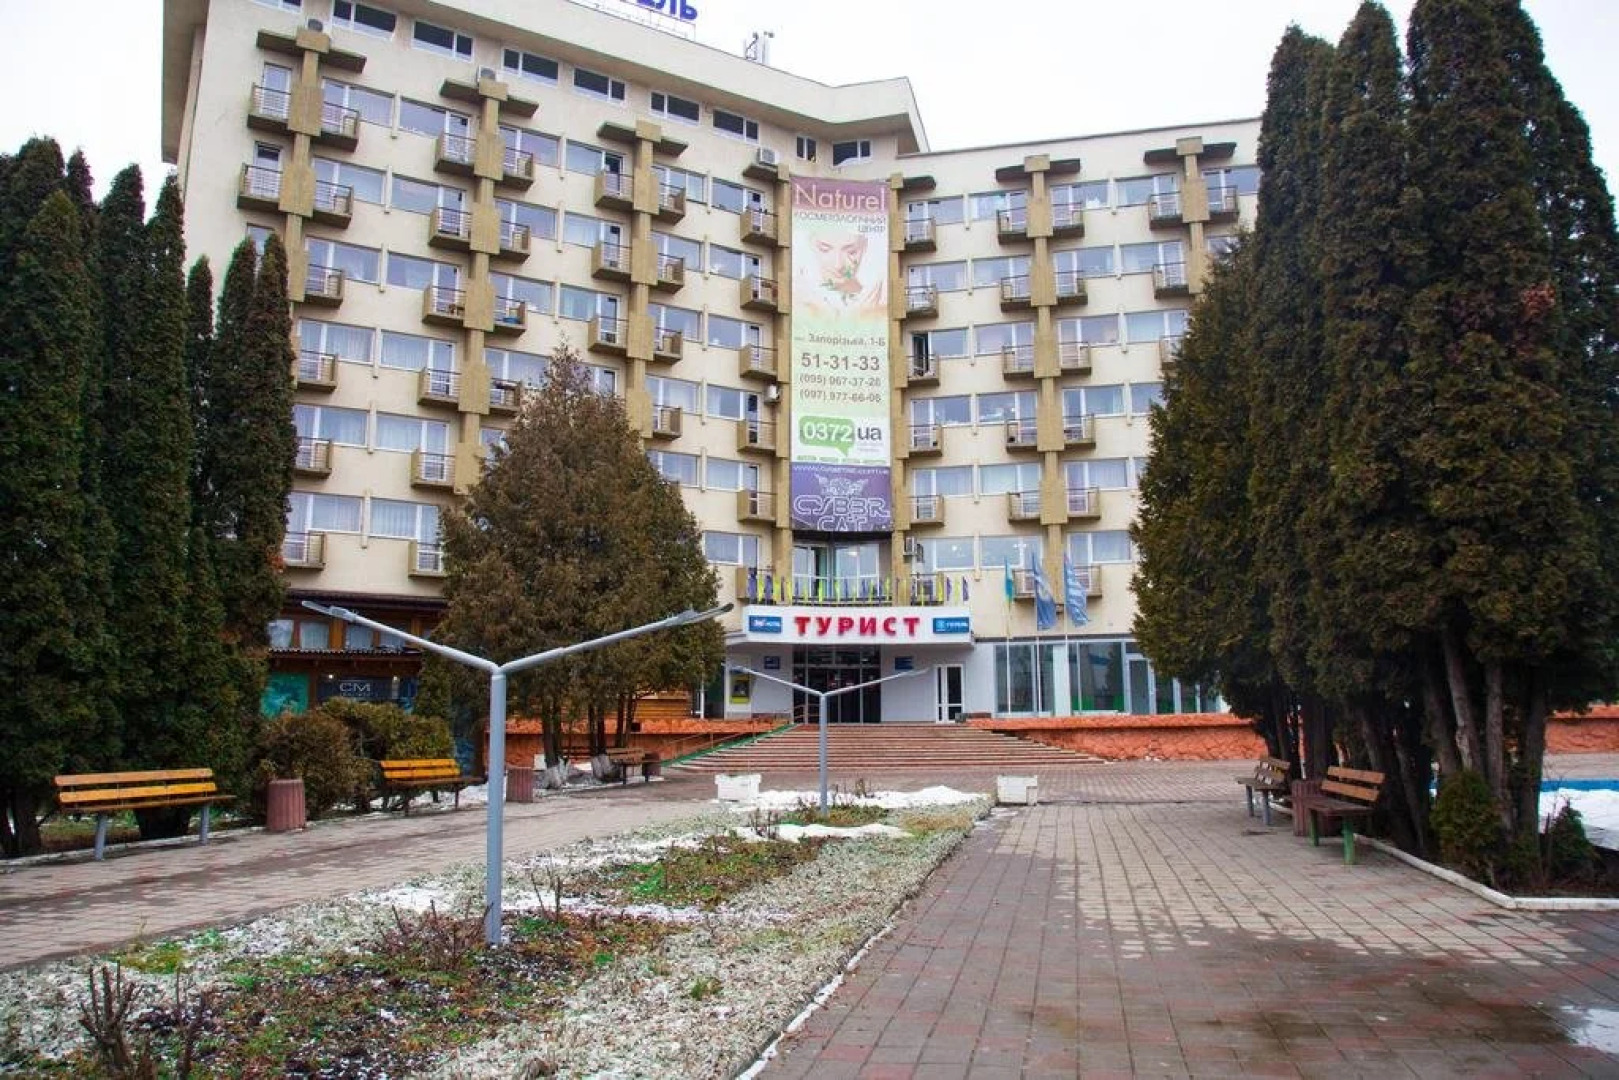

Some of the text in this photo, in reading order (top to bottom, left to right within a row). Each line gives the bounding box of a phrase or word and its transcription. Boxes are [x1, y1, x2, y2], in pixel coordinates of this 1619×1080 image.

[795, 183, 886, 213] Naturel
[801, 352, 880, 371] 51-31-33
[802, 421, 882, 442] 0372 ua
[794, 616, 921, 637] ТУРИСТ
